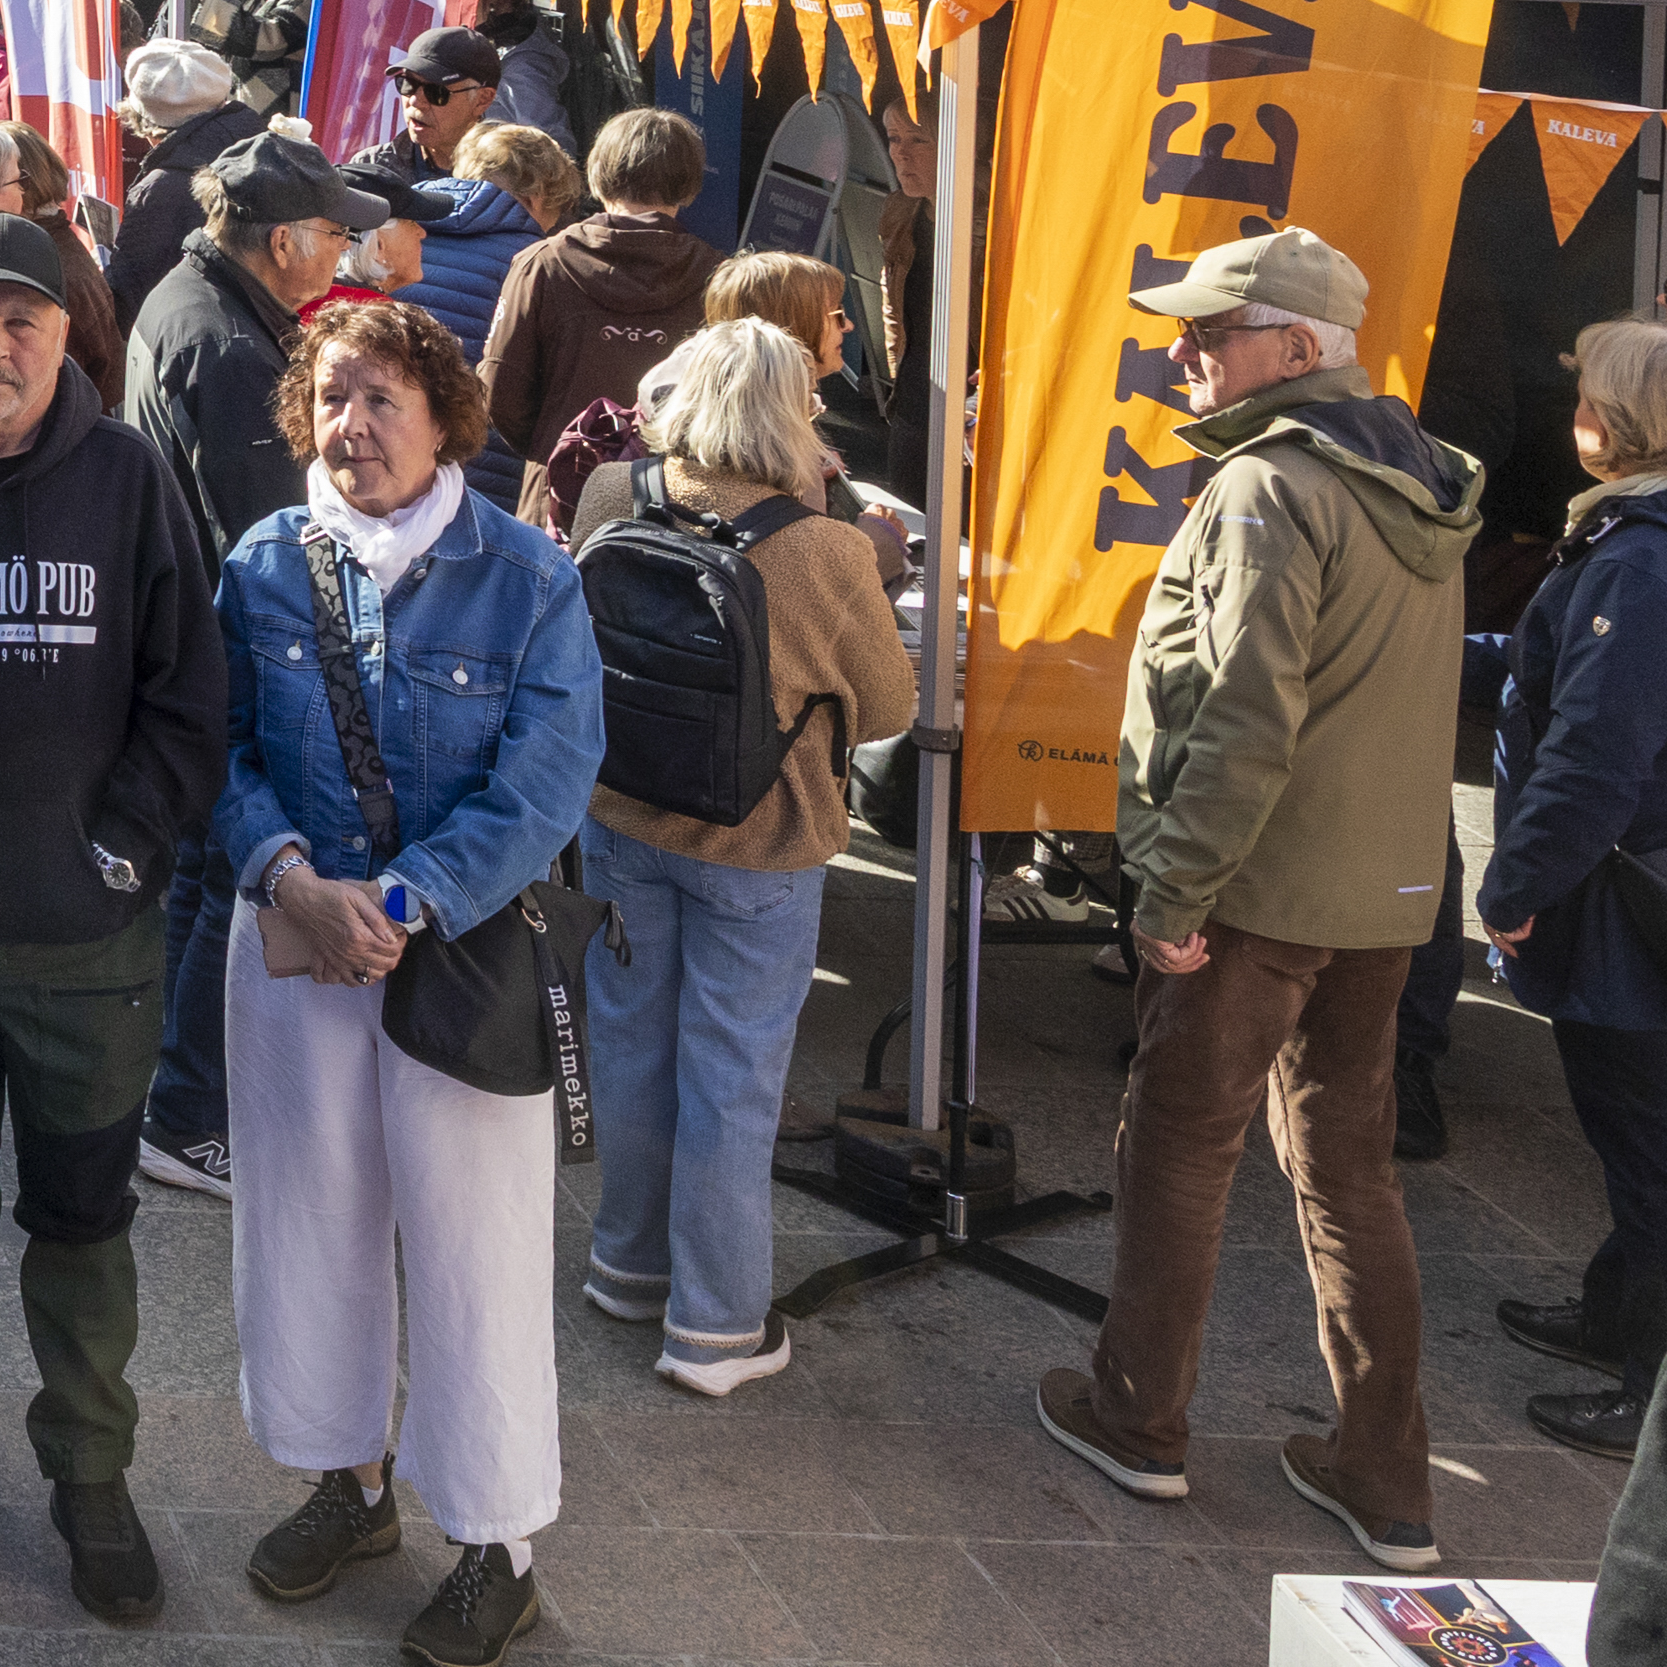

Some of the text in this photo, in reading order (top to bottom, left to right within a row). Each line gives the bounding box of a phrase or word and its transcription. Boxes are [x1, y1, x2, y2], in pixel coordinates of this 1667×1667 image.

[1546, 118, 1618, 147] KALEVA
[36, 560, 96, 617] PUB
[1048, 747, 1109, 767] ELÄMÄ
[548, 984, 590, 1148] marimekko
